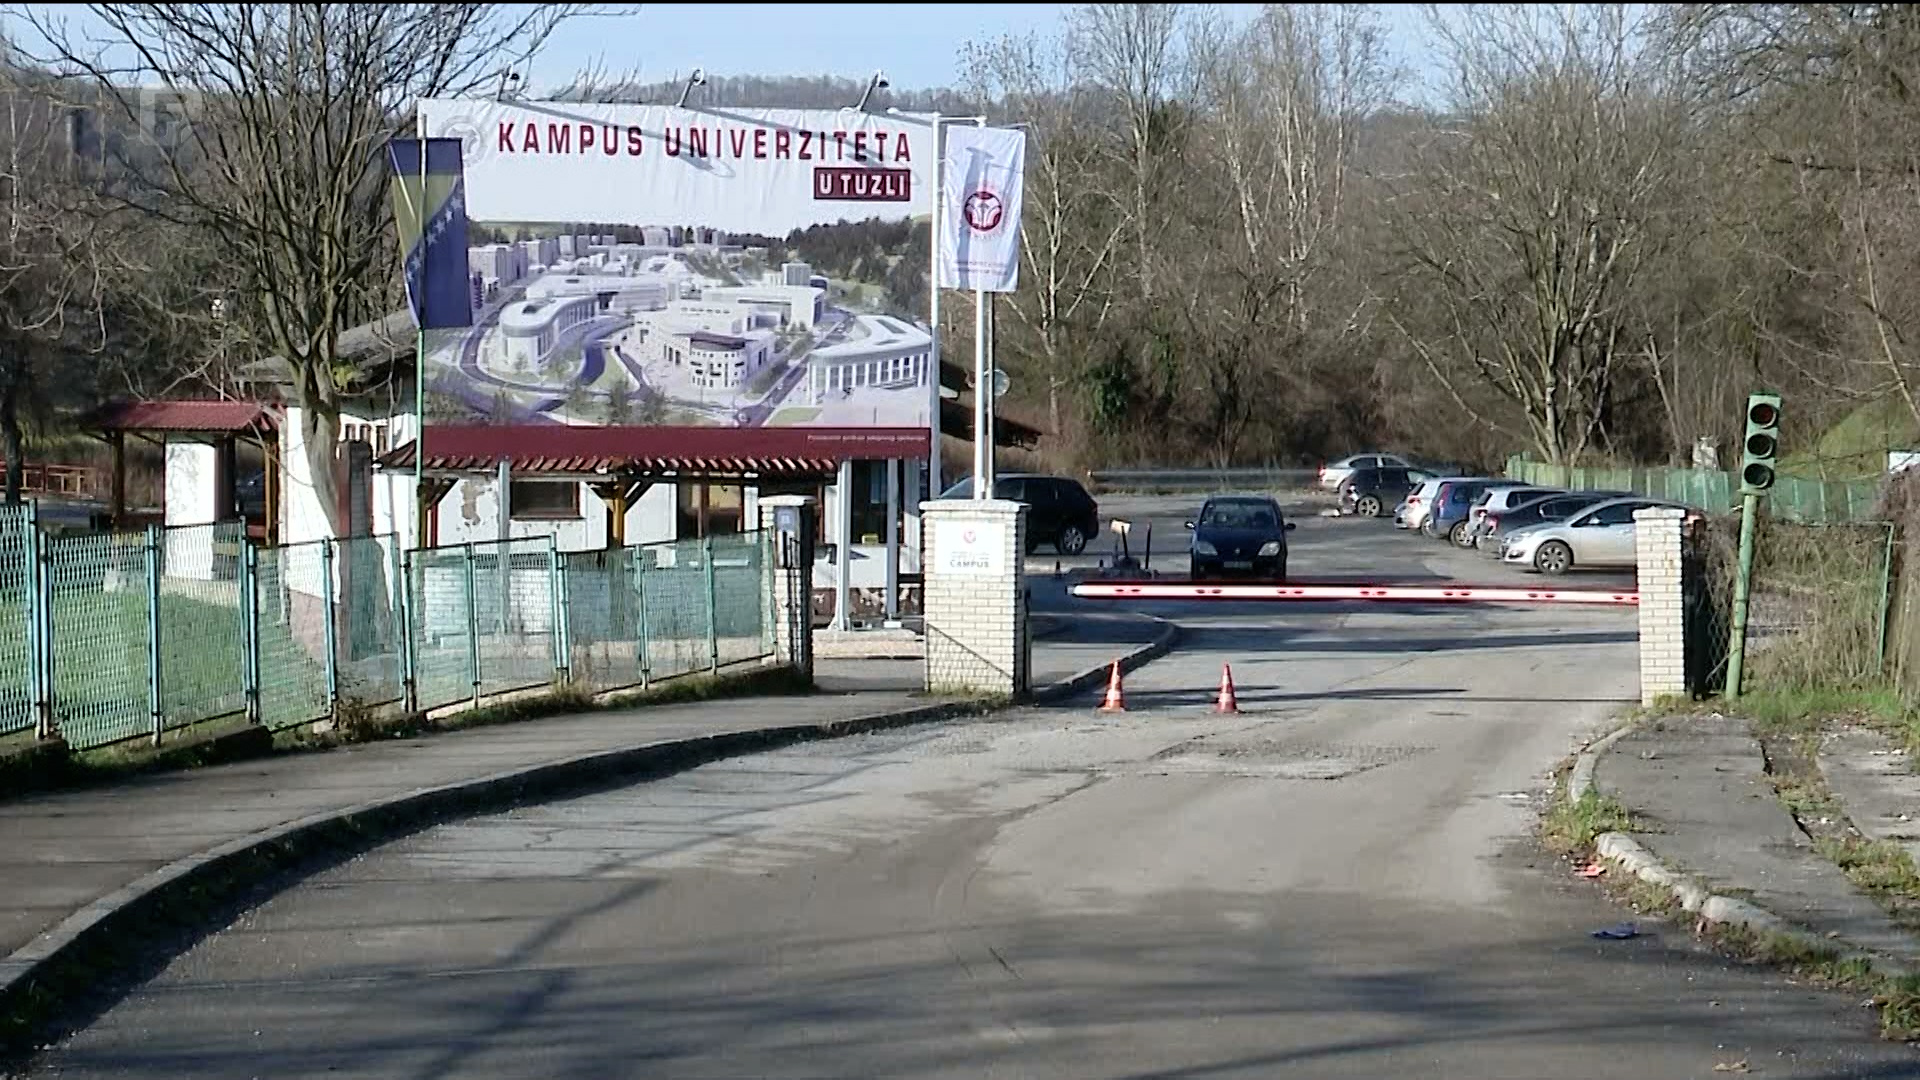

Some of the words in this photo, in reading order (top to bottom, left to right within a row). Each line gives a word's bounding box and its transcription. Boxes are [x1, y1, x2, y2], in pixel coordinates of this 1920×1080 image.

[499, 122, 643, 156] KAMPUS
[665, 127, 911, 161] UNIVERZITETA
[818, 172, 834, 195] U
[839, 174, 905, 196] TUZLI
